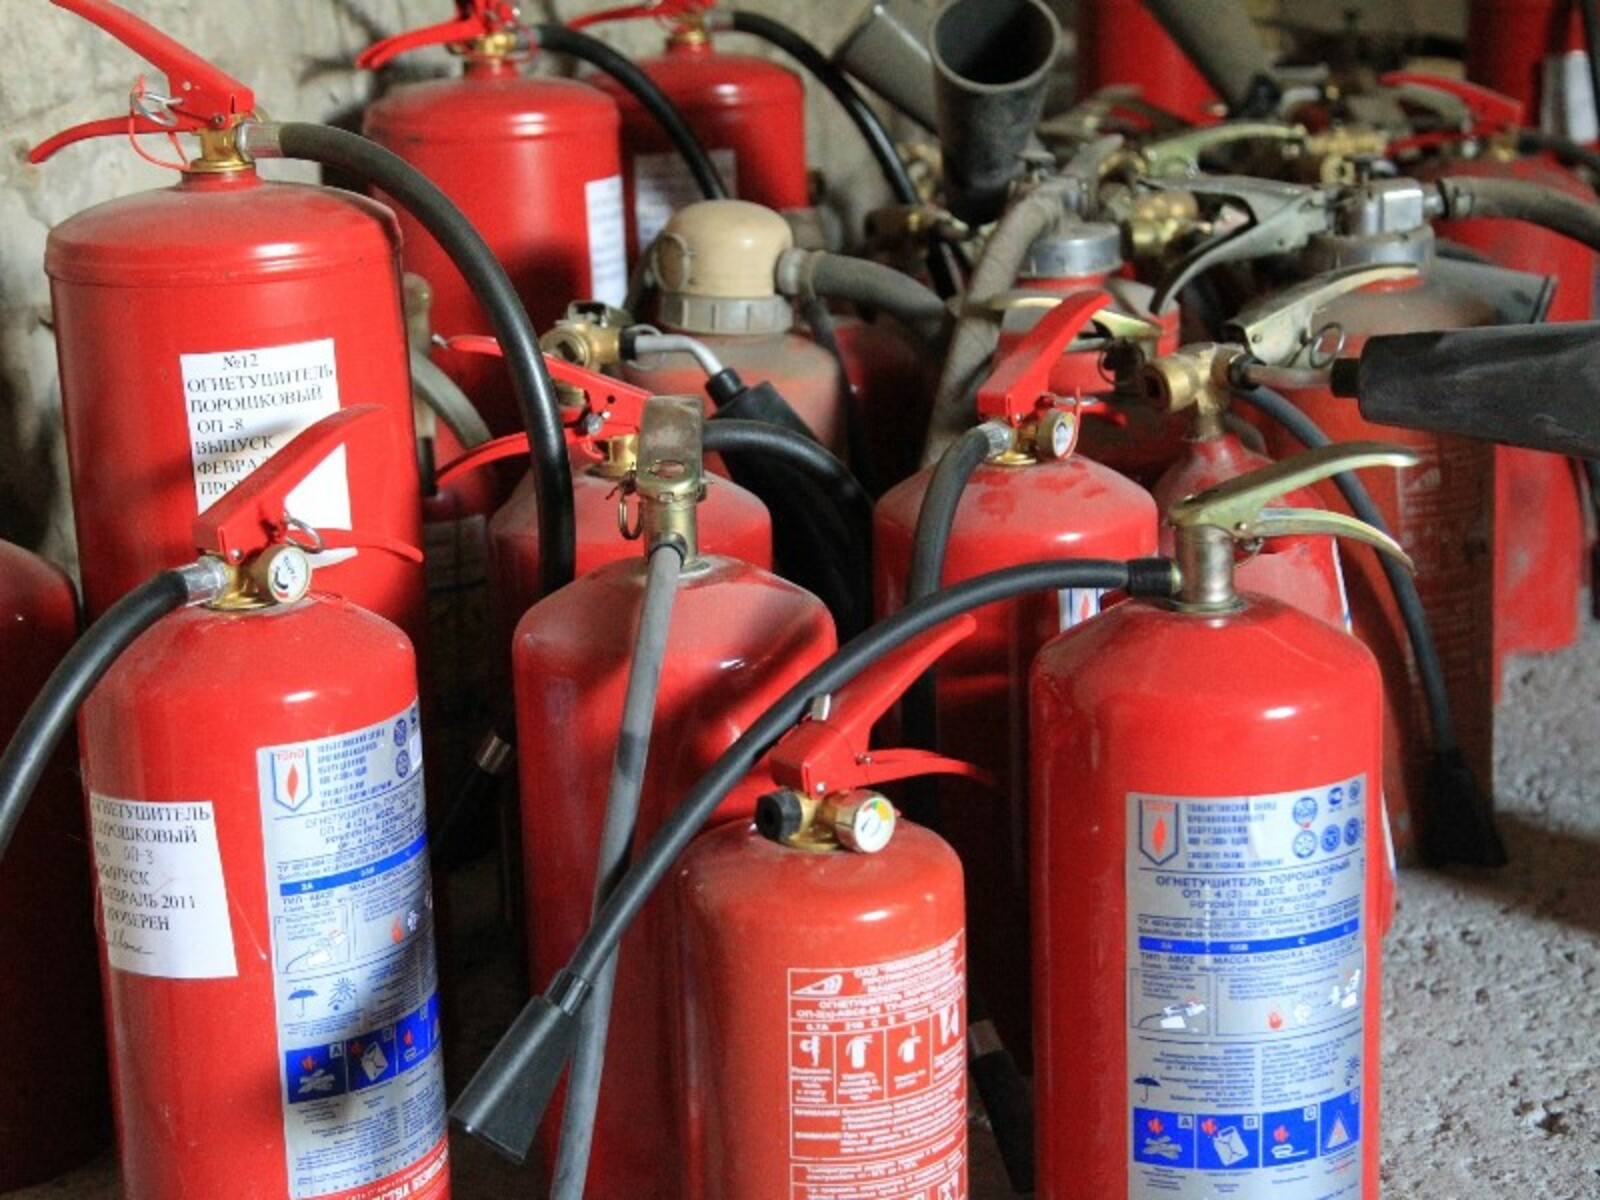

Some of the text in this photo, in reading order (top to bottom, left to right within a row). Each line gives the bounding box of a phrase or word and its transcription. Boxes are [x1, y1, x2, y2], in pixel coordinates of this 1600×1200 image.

[222, 353, 258, 371] №12
[187, 363, 334, 393] ОГНЕТУШИТЕЛЬ
[189, 385, 324, 414] ПОРОШКОВЫЙ
[196, 419, 224, 434] ОП
[195, 435, 275, 455] ВЫПУСК
[196, 457, 266, 476] ФЕВРА
[1155, 875, 1265, 889] ОГНЕТУШИТЕЛЬ
[161, 894, 196, 910] 2011
